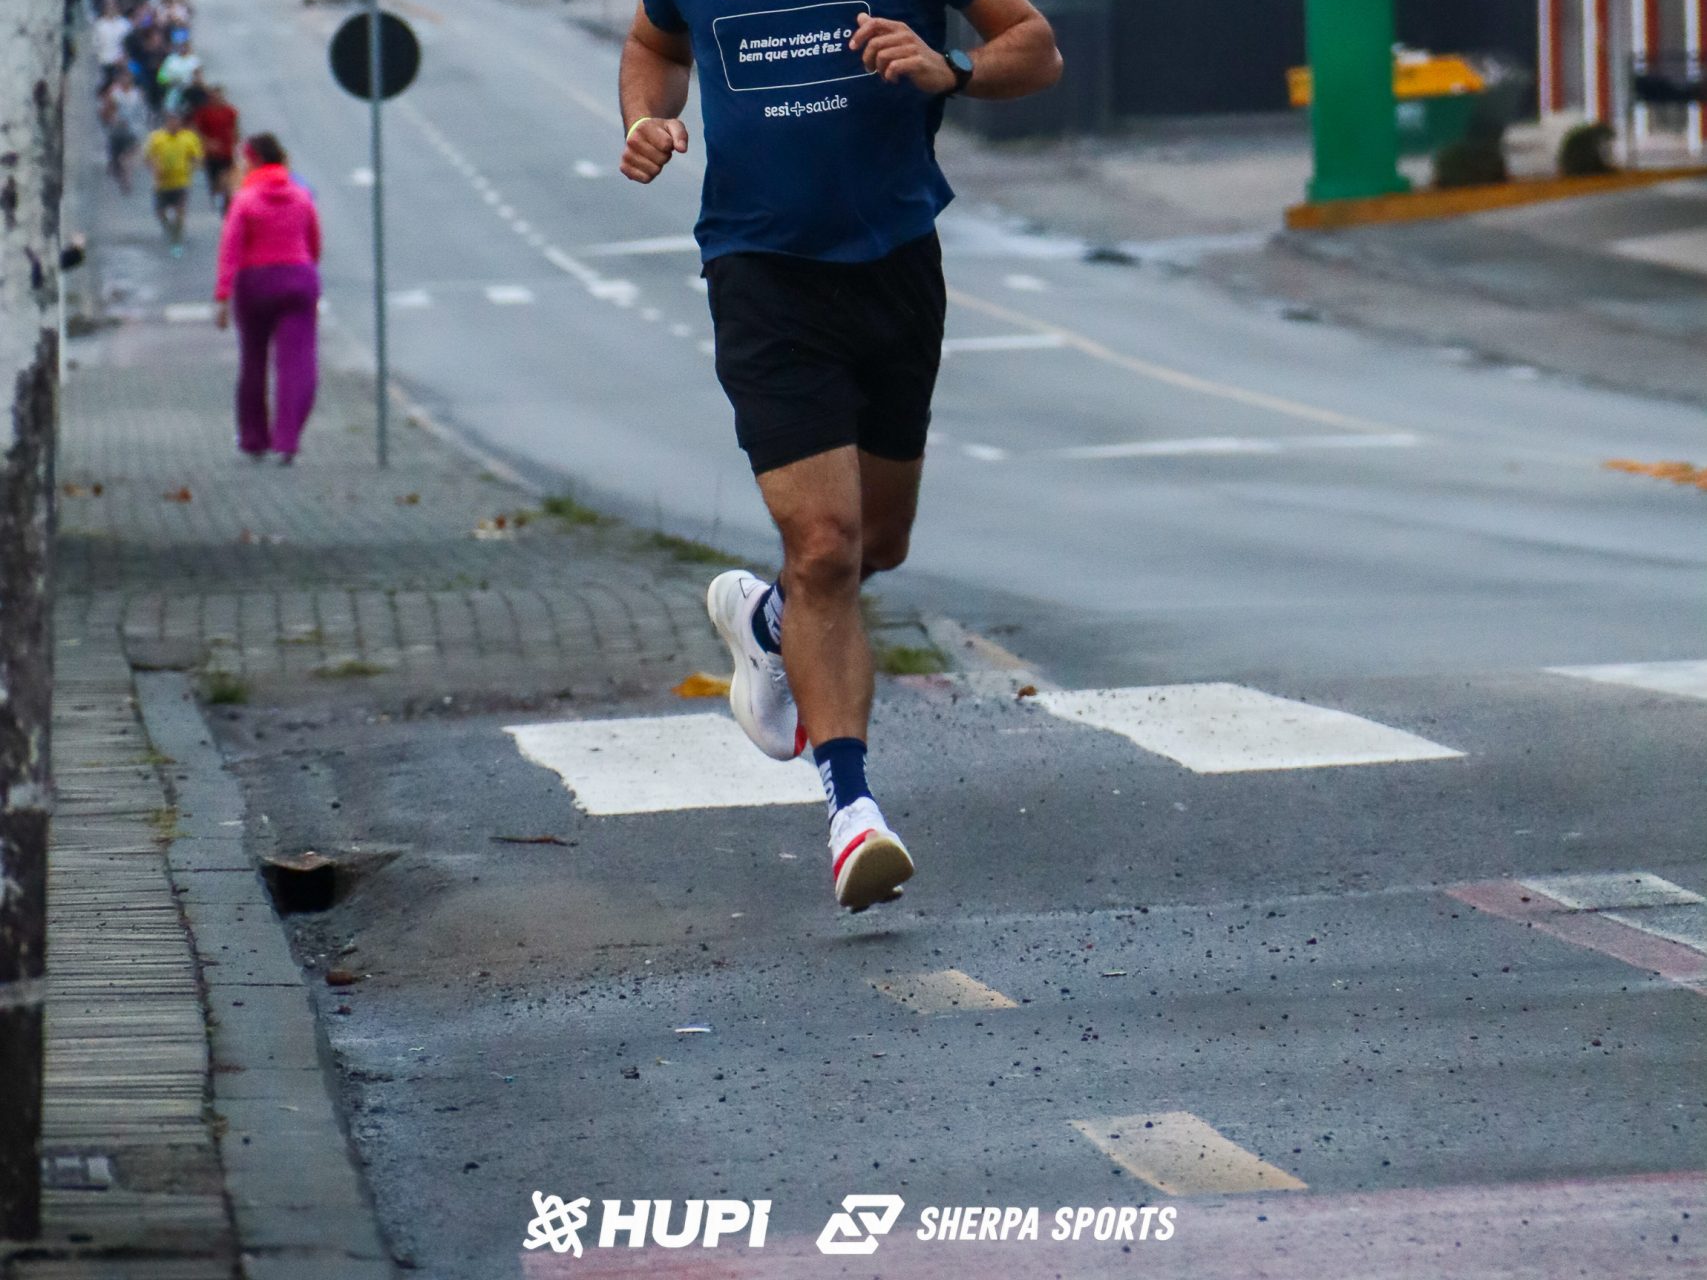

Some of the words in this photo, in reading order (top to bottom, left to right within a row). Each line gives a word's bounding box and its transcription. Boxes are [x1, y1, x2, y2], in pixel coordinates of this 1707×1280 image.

[739, 39, 748, 50] A
[750, 37, 787, 49] maior
[789, 31, 831, 46] vitória
[833, 28, 841, 39] é
[843, 29, 852, 38] o
[739, 52, 763, 63] bem
[765, 50, 788, 62] que
[790, 44, 820, 58] você
[822, 42, 842, 54] faz
